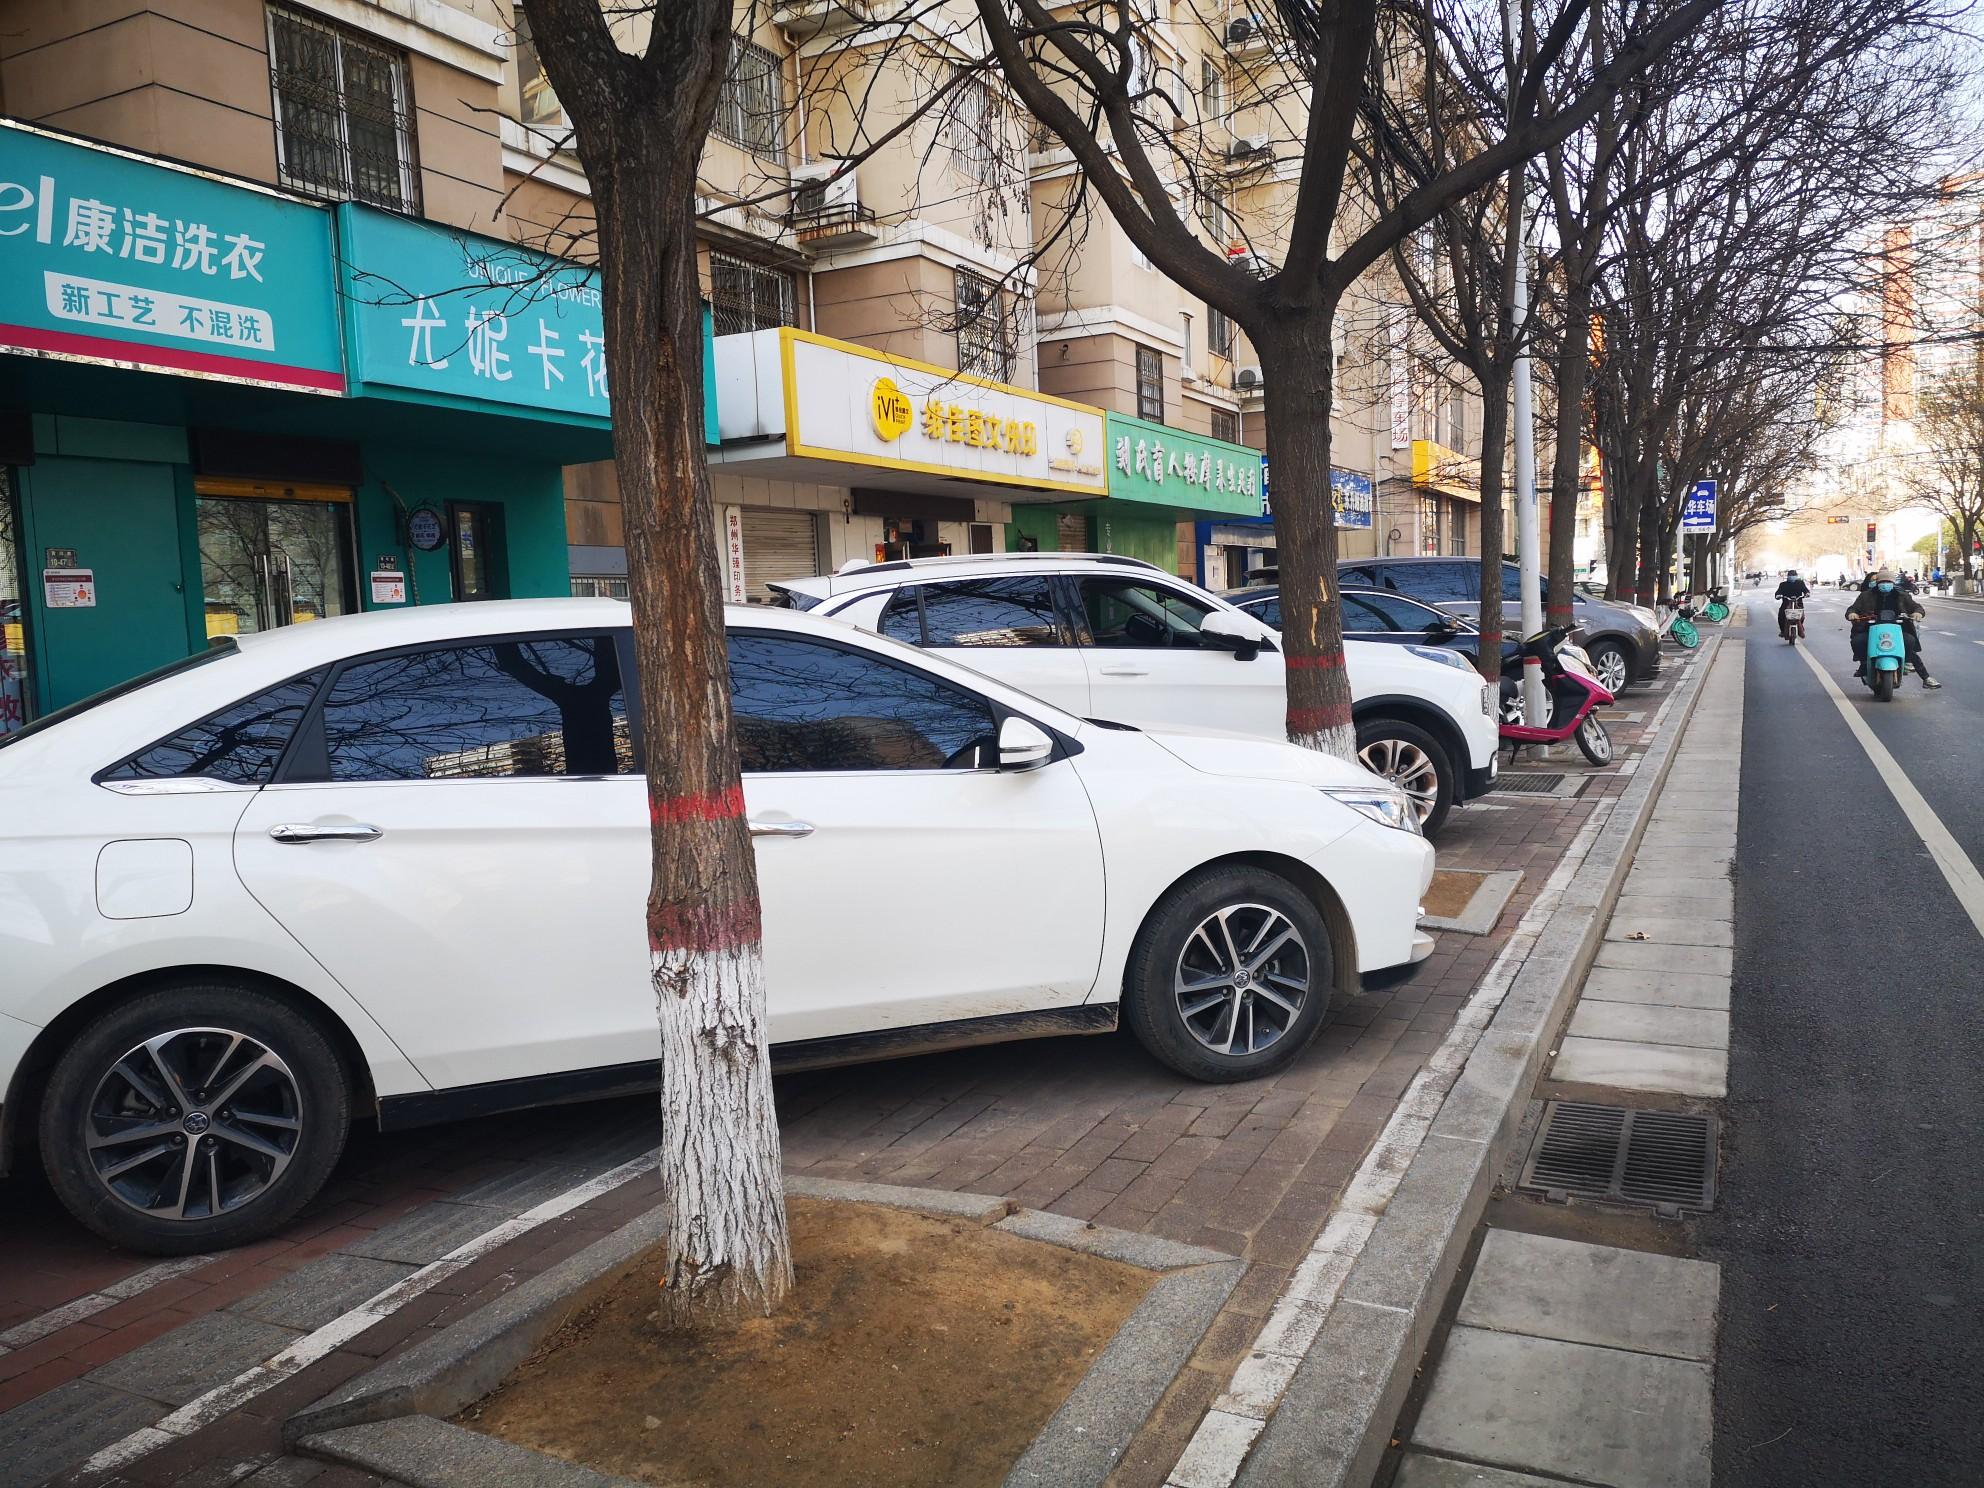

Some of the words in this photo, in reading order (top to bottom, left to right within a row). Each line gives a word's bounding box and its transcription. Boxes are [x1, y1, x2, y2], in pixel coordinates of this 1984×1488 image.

[63, 197, 266, 283] 康洁洗衣
[466, 258, 530, 292] UNIQUE
[61, 283, 156, 327] 新工艺
[179, 304, 262, 344] 不混洗
[1683, 499, 1715, 516] 华车场
[730, 514, 742, 602] 郑州华印务
